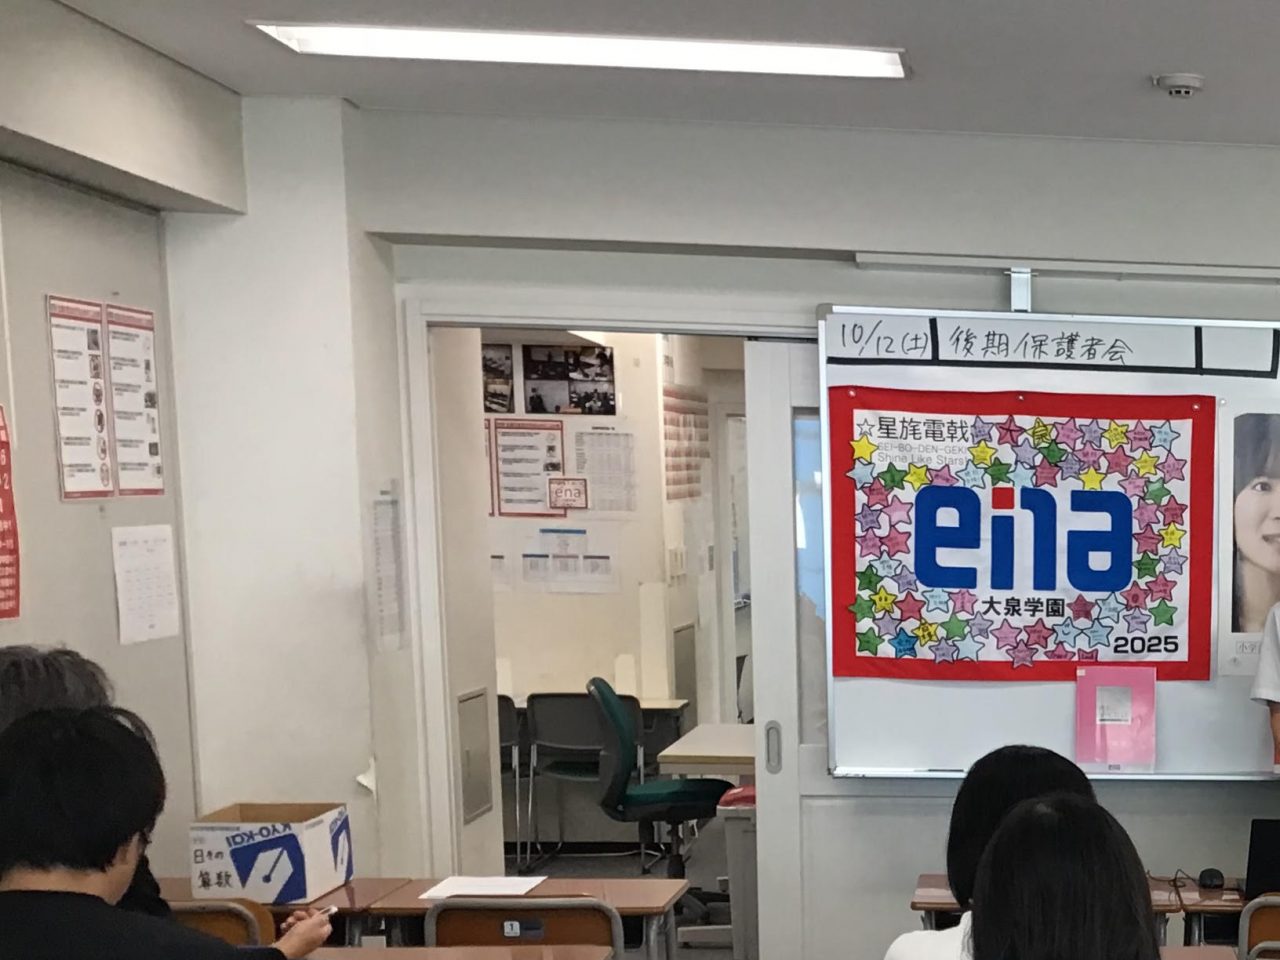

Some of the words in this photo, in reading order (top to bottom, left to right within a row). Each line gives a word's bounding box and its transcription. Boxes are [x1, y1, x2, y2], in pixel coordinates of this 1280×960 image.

[911, 453, 933, 464] Like
[982, 596, 1066, 618] 大泉学園
[1113, 635, 1179, 654] 2025
